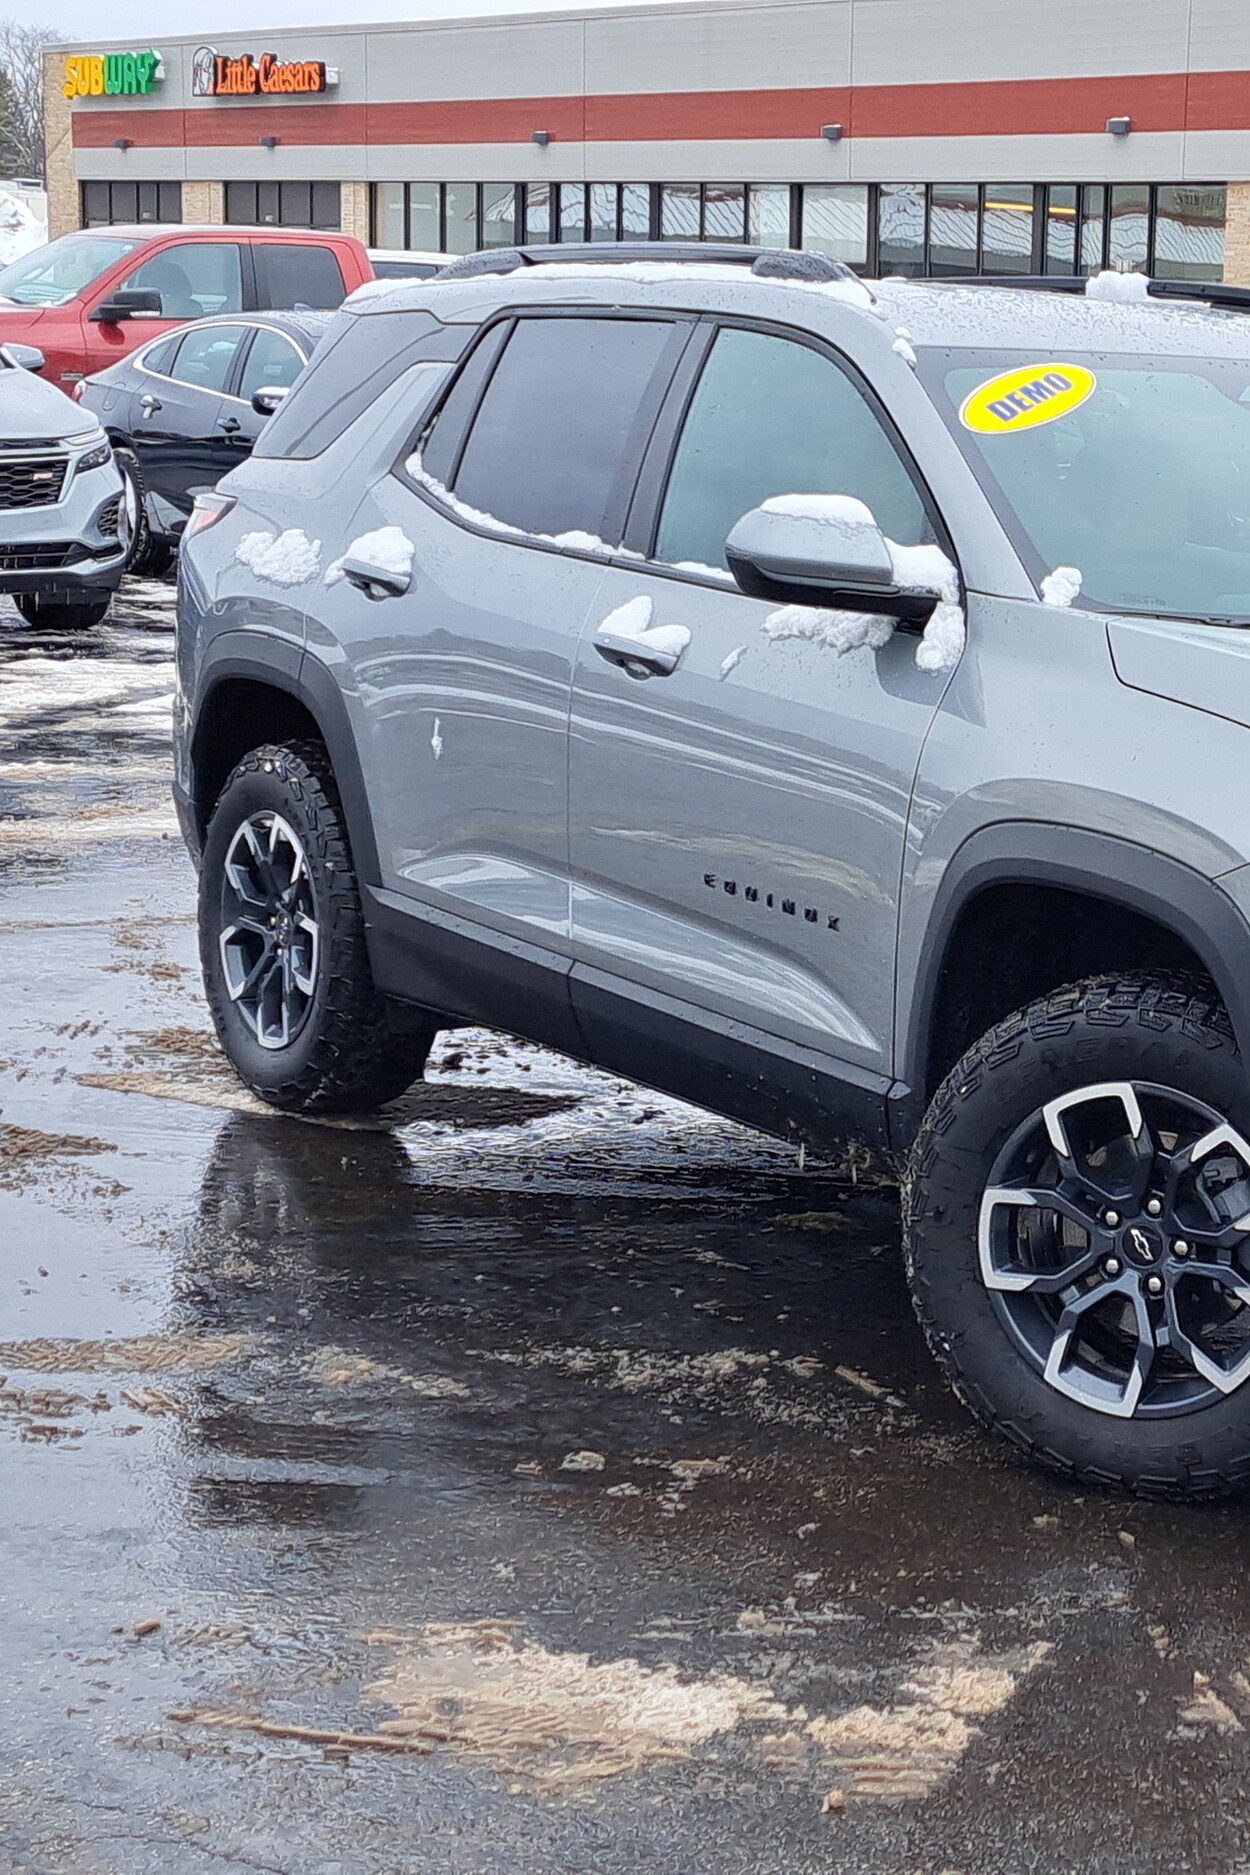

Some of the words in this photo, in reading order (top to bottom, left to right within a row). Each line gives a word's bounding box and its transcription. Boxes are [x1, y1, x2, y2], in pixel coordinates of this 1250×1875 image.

[63, 49, 158, 98] SUBWAY
[215, 55, 256, 94] Little
[259, 53, 321, 93] Caesars
[986, 371, 1073, 422] DEMO
[703, 873, 841, 932] EQUINOX
